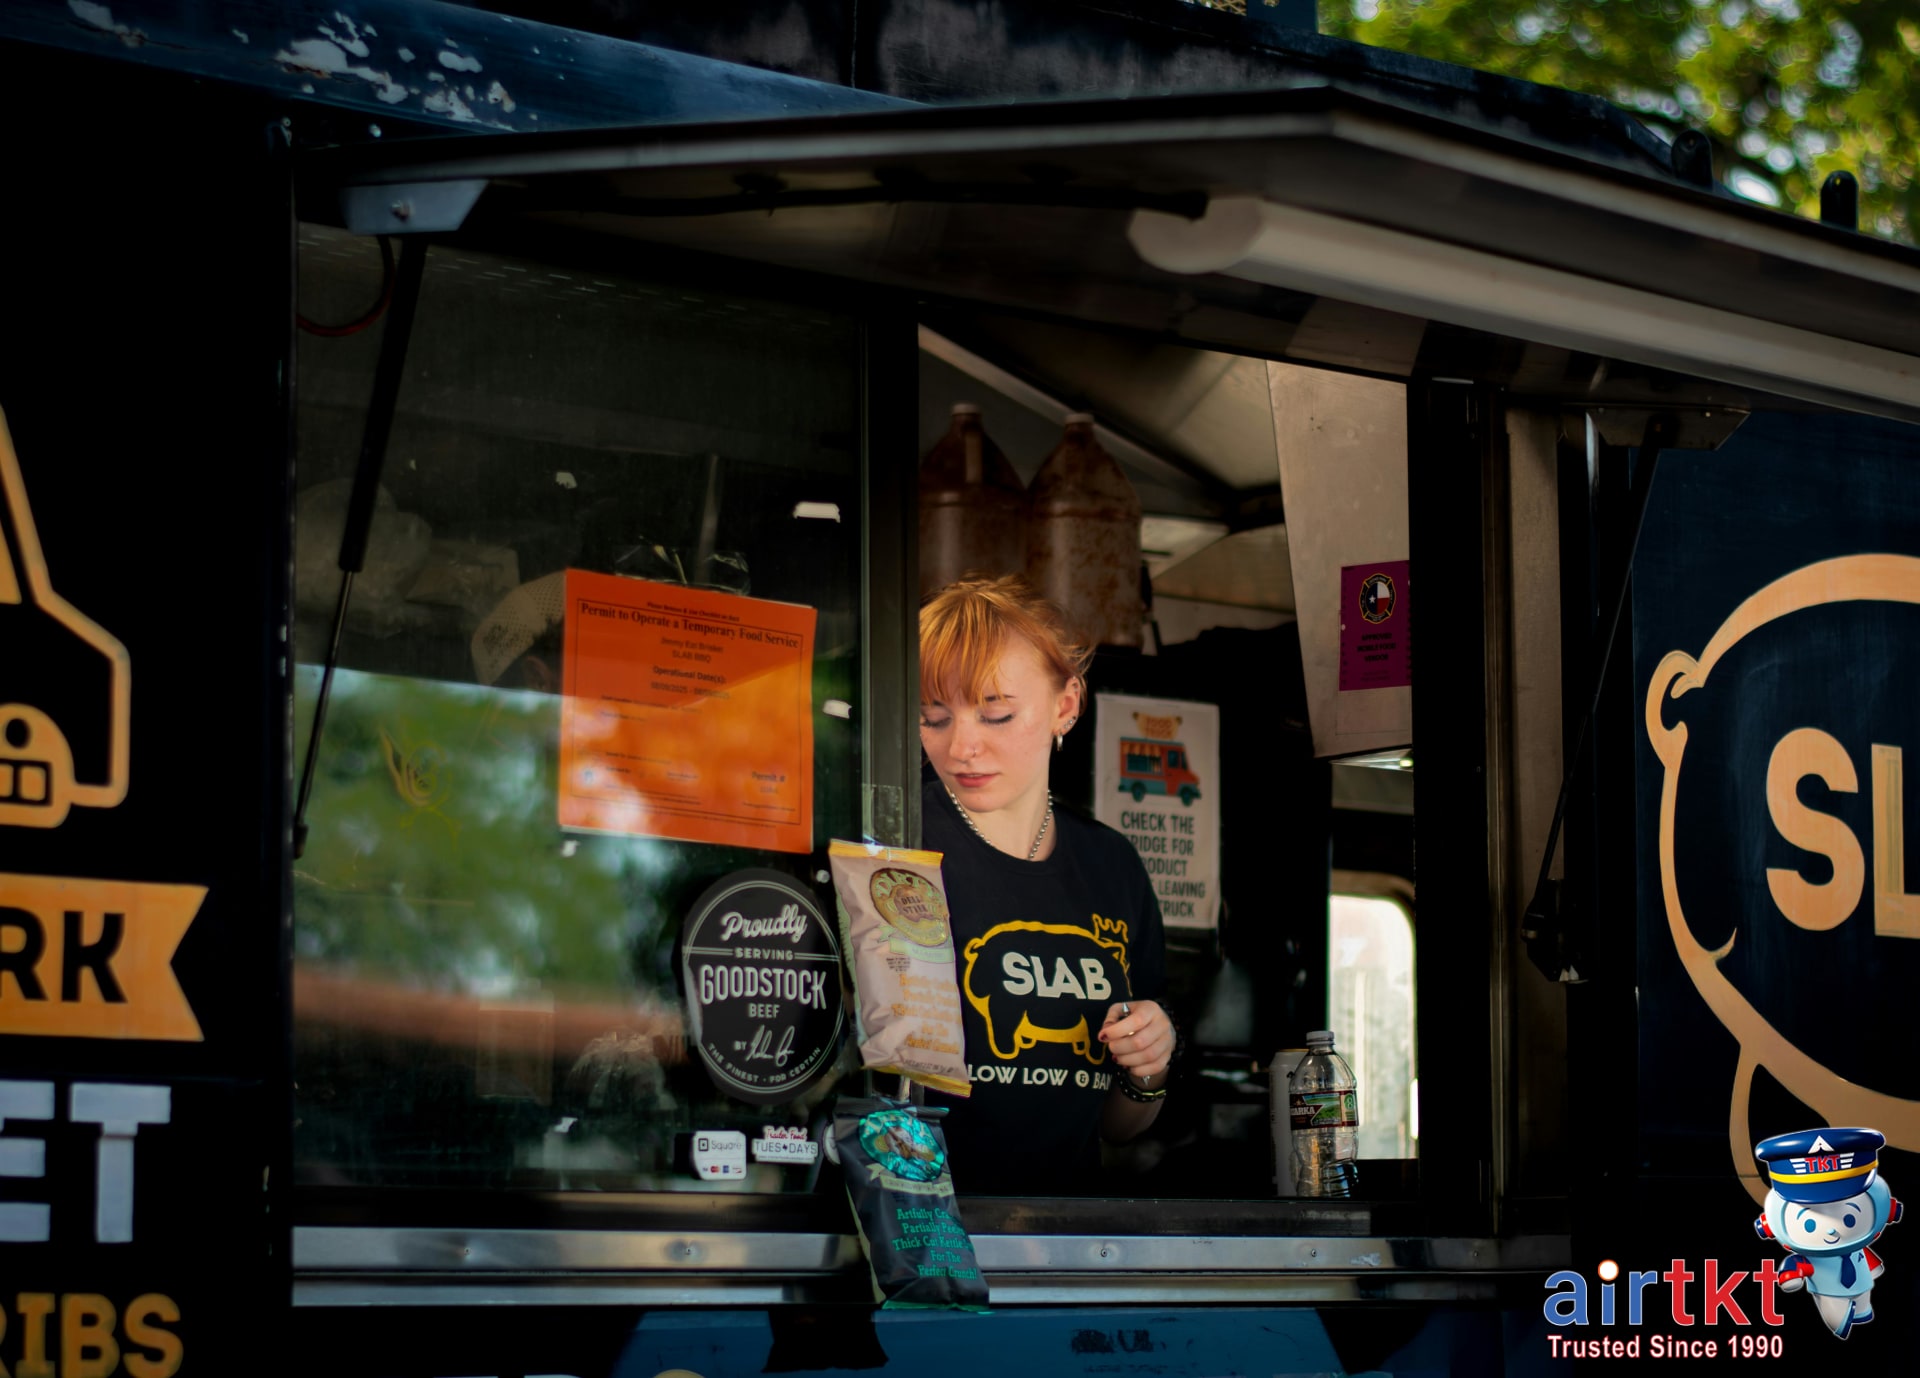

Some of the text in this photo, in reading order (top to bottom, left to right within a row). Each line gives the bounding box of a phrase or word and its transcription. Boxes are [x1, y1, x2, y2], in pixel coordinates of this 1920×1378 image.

[582, 602, 799, 648] Permit to Operate a Temporary Food Service
[653, 666, 695, 678] Operational
[1121, 810, 1195, 835] CHECK THE
[1172, 838, 1194, 856] FOR
[1158, 880, 1206, 898] LEAVING
[901, 896, 921, 905] DELI
[720, 904, 807, 943] Proudly
[734, 947, 794, 961] SERVING
[1002, 951, 1112, 1000] SLAB
[700, 964, 827, 1010] GOODSTOCK
[748, 1003, 780, 1018] BEEF
[734, 1040, 746, 1050] BY
[707, 1042, 724, 1064] THE
[725, 1062, 759, 1083] FINEST
[769, 1072, 787, 1083] FOR
[790, 1047, 821, 1078] CERTAIN
[1023, 1067, 1068, 1086] LOW
[1075, 1070, 1090, 1088] &
[766, 1128, 806, 1140] Trailer Food
[711, 1140, 742, 1152] Square
[896, 1207, 933, 1220] Artfully
[902, 1222, 941, 1235] Partially
[892, 1236, 921, 1250] Thick
[923, 1235, 937, 1247] Cut
[930, 1250, 961, 1263] For The
[917, 1264, 977, 1279] Perfect Crunch!
[0, 1292, 184, 1378] IBS
